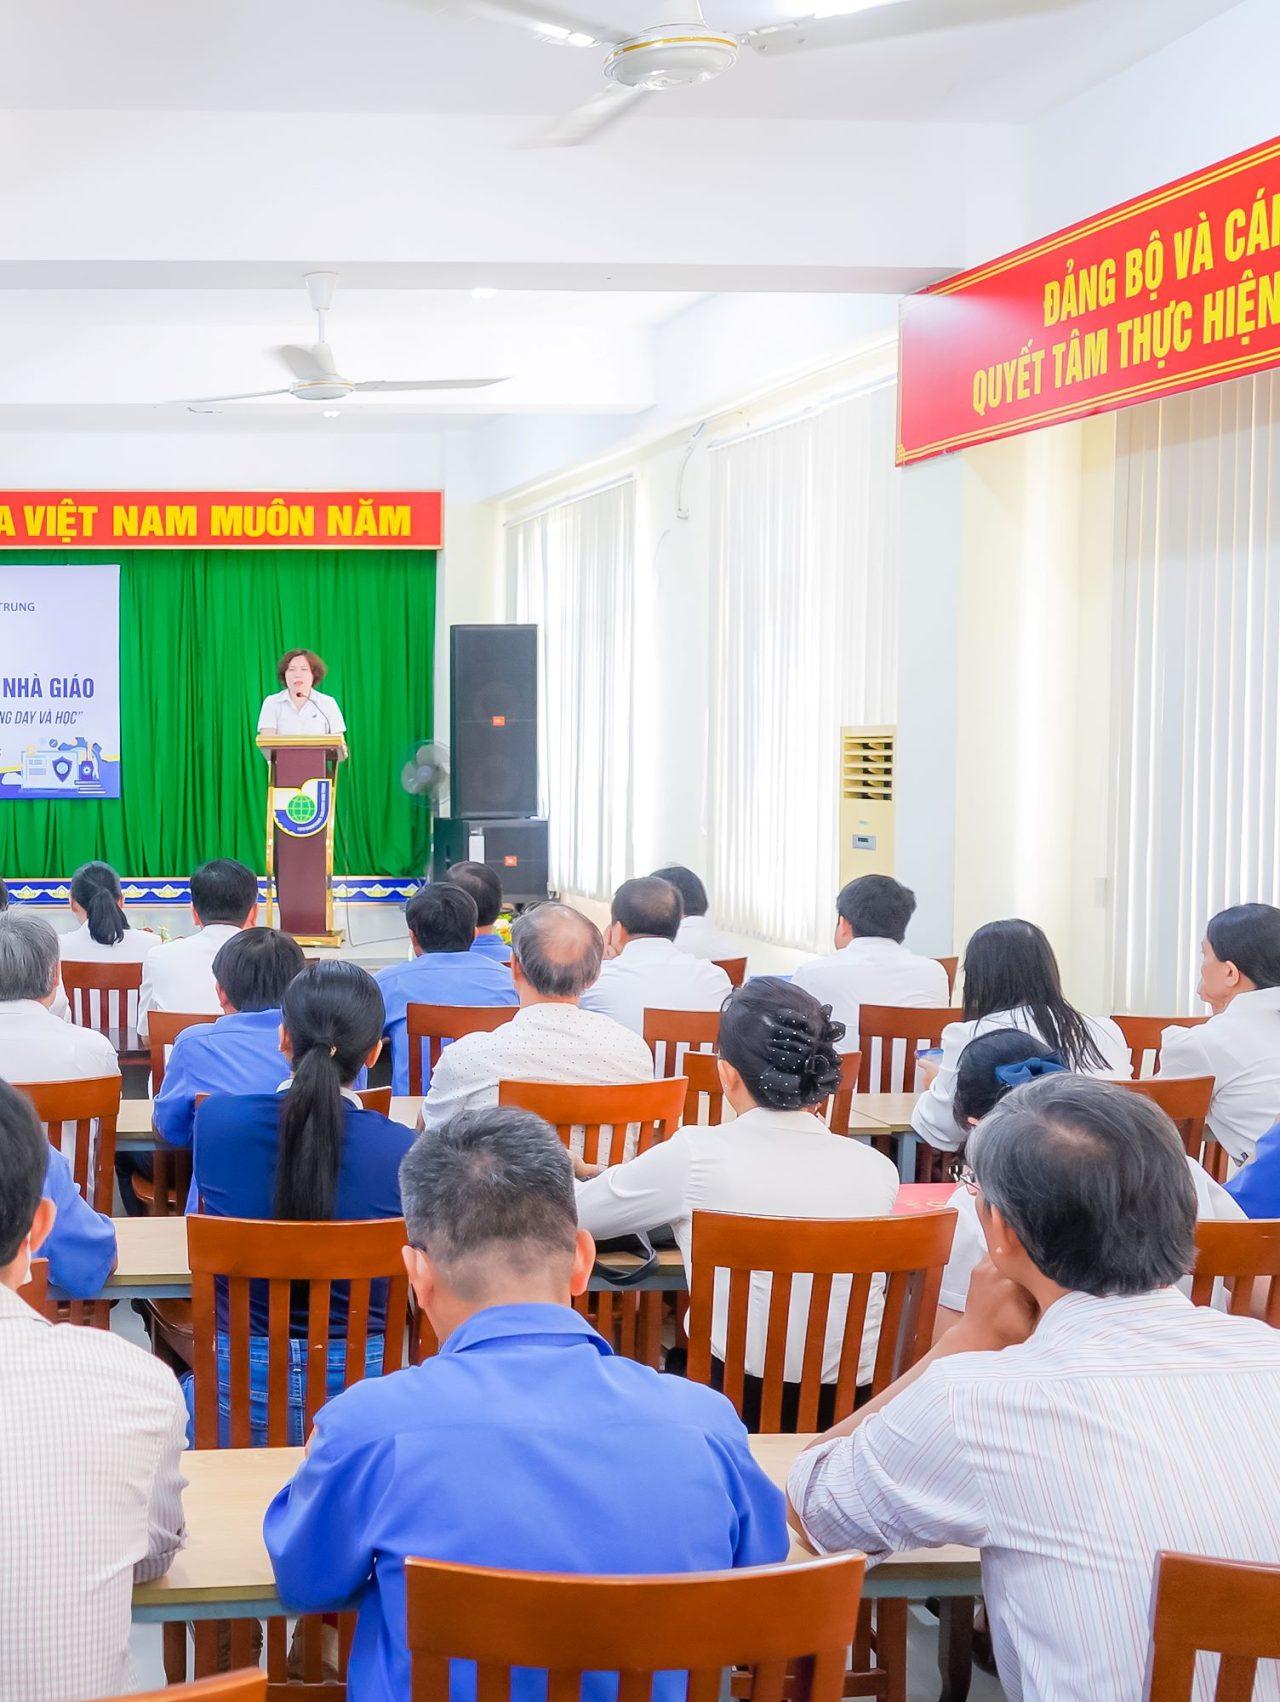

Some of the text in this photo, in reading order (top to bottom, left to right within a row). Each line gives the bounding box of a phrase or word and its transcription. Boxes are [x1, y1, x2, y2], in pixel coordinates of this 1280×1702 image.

[1043, 258, 1116, 328] ĐẢNG
[1125, 229, 1164, 301] BỘ
[1174, 210, 1214, 280] VÀ
[972, 268, 1280, 417] QUYẾT TÂM THỰC HIỆN
[24, 498, 99, 543] VIỆT
[113, 505, 198, 537] NAM
[210, 498, 315, 537] MUÔN
[327, 498, 412, 537] NĂM
[2, 673, 44, 699] NHÀ
[49, 673, 95, 699] GIÁO
[39, 709, 52, 725] VÀ
